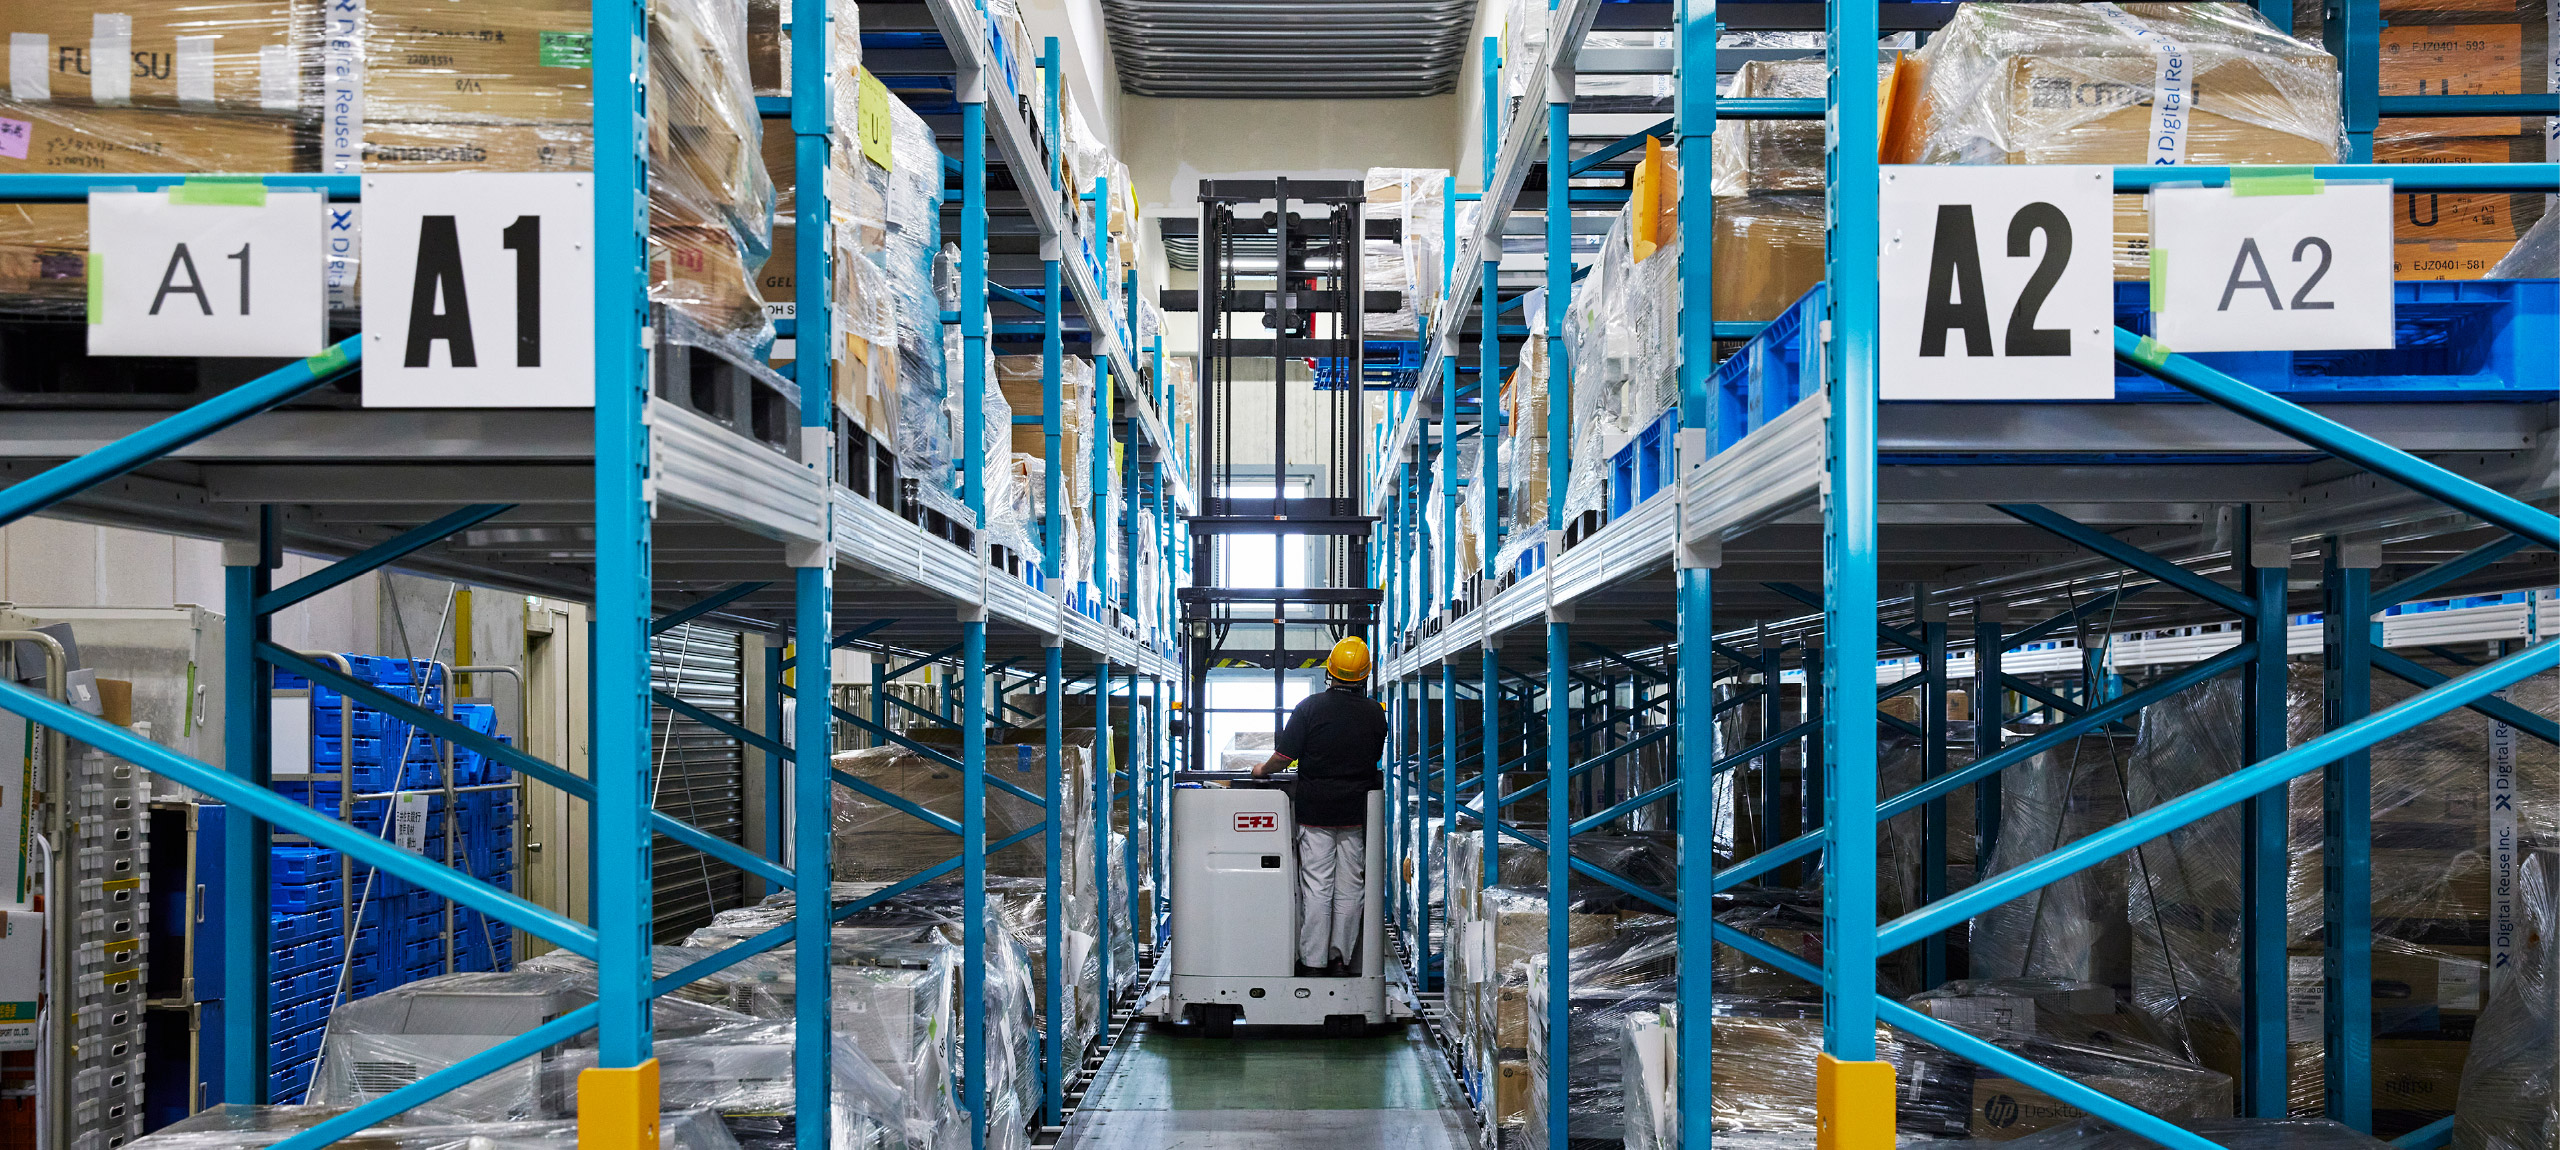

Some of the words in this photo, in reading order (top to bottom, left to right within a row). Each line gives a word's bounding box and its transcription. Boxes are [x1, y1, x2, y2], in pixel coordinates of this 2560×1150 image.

[59, 46, 171, 80] FUSU
[335, 89, 353, 149] Reuse
[2158, 86, 2182, 151] Digital
[361, 141, 487, 163] Panasonic
[148, 242, 251, 316] A1
[1919, 201, 2073, 357] A2
[2217, 236, 2335, 312] A2
[2413, 260, 2485, 271] EJZ0401-581
[403, 214, 542, 368] A1
[2496, 735, 2512, 789] Digital
[1237, 815, 1275, 828] ニチユ
[2497, 826, 2511, 851] Inc.
[27, 826, 35, 864] YAMATO
[2498, 854, 2511, 896] Reuse
[2497, 899, 2514, 948] Digital
[1987, 1094, 2017, 1128] hp
